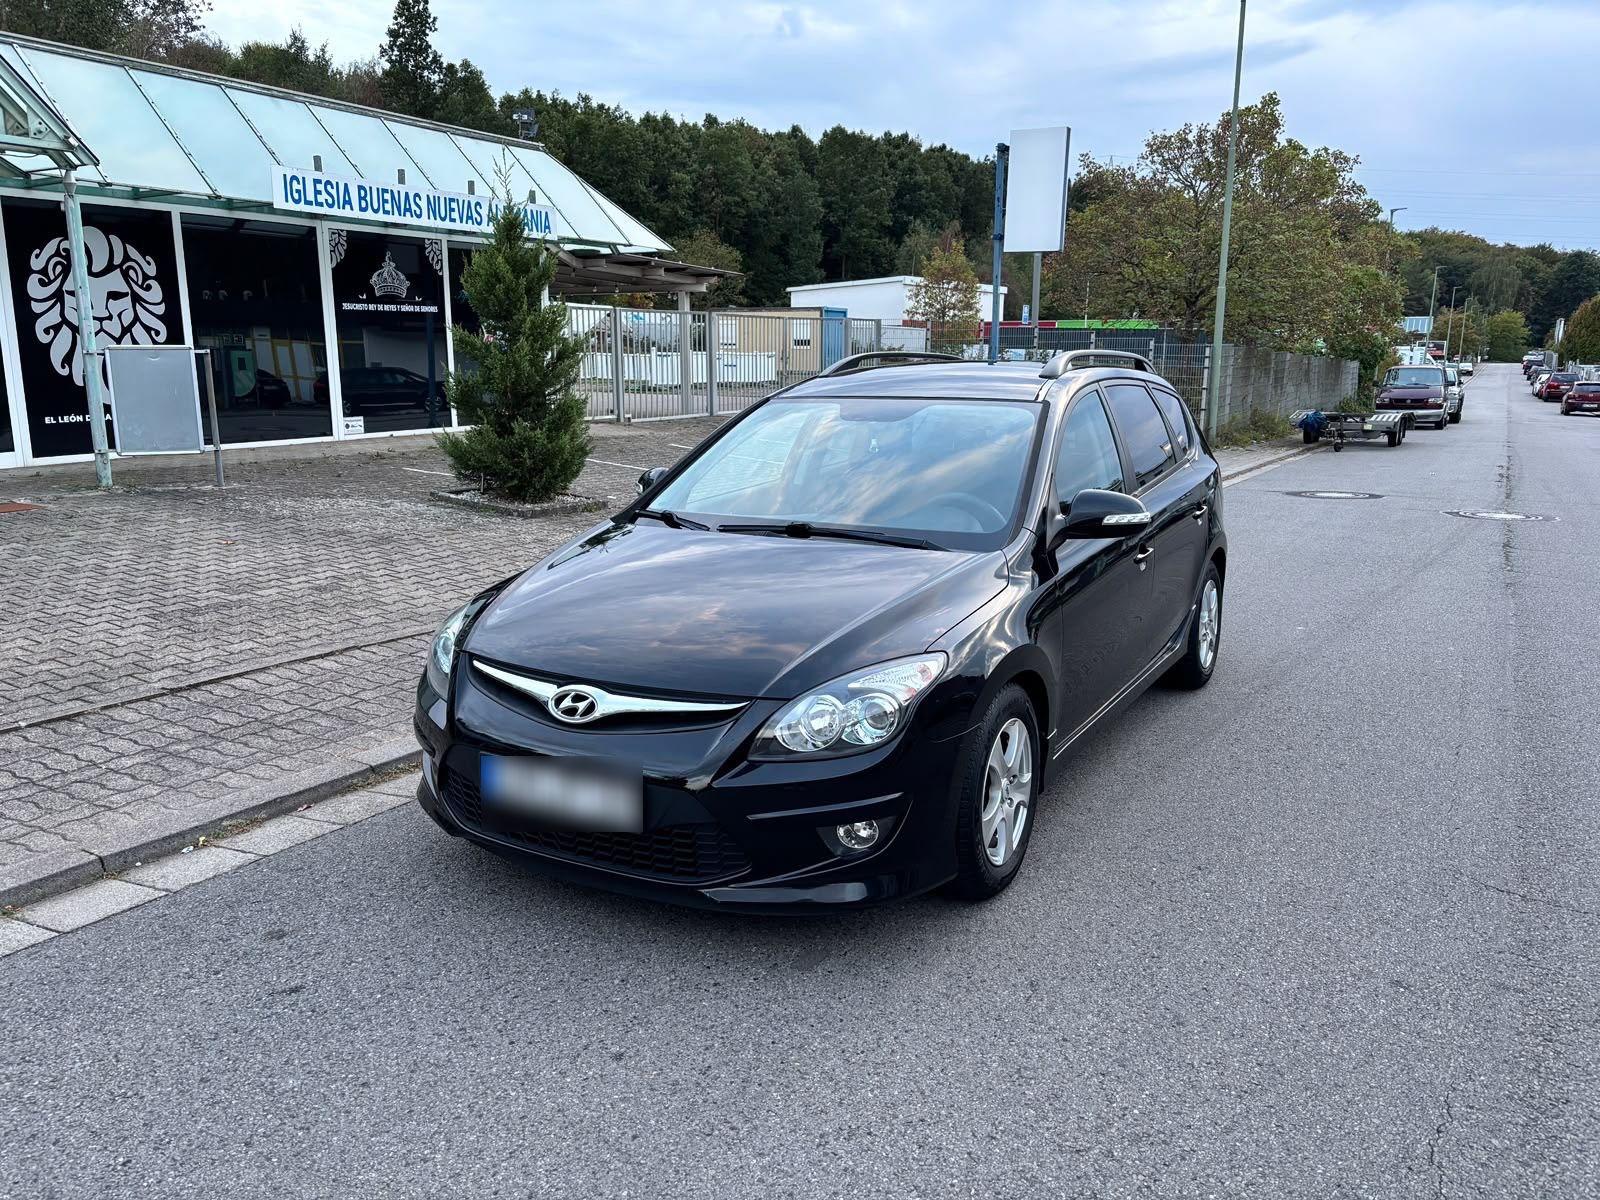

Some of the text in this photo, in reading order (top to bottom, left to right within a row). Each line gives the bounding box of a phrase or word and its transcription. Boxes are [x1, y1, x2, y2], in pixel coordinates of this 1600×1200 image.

[283, 174, 354, 211] IGLESIA
[357, 185, 423, 219] BUENAS
[426, 194, 483, 227] NUEVAS
[342, 303, 368, 311] JESUCRISTO
[384, 304, 397, 312] REYES
[45, 416, 56, 424] EL
[58, 414, 83, 423] LEÓN
